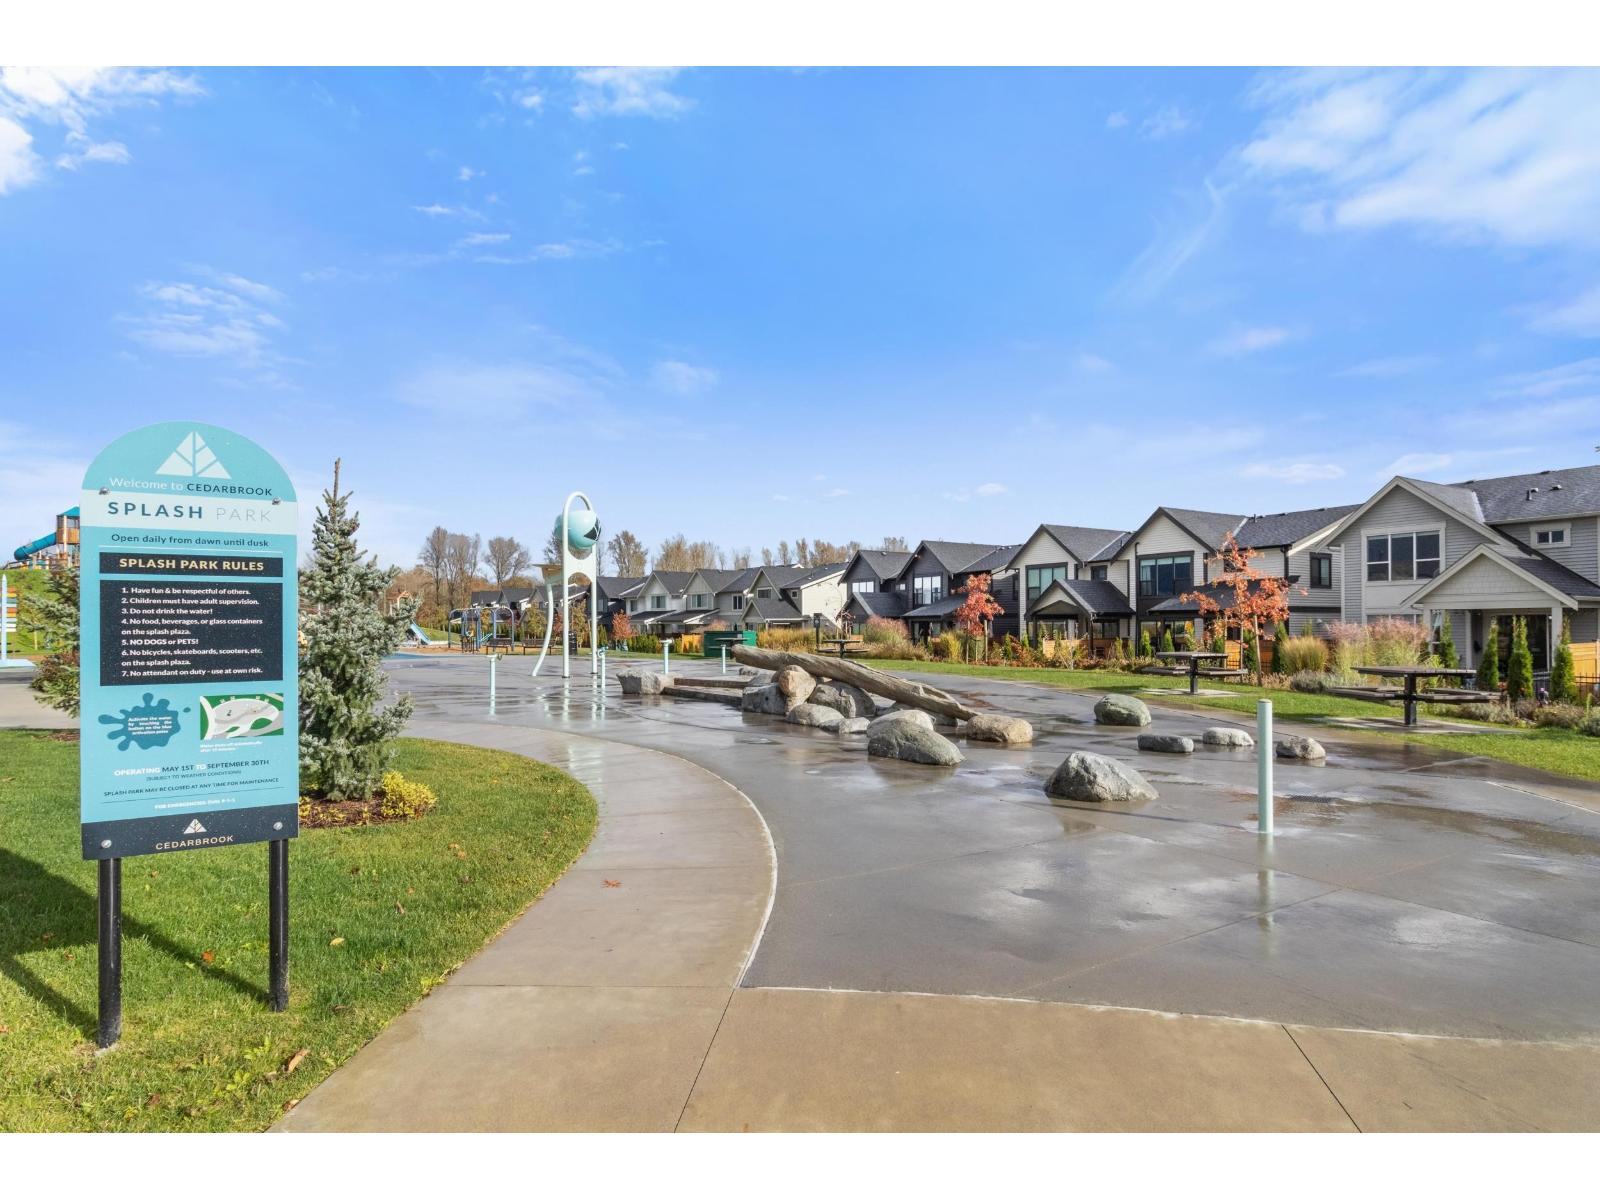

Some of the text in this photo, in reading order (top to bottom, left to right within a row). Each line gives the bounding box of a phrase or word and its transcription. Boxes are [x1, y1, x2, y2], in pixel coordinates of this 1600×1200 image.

[110, 478, 272, 496] Welcome to CEDARBROOK
[108, 502, 272, 522] SPLASH PARK
[111, 534, 270, 547] Open daily from dawn until dusk
[119, 558, 264, 571] SPLASH PARK RULES
[114, 767, 160, 776] OPERATING
[207, 760, 250, 769] SEPTEMBER
[155, 834, 234, 850] CEDARBROOK
